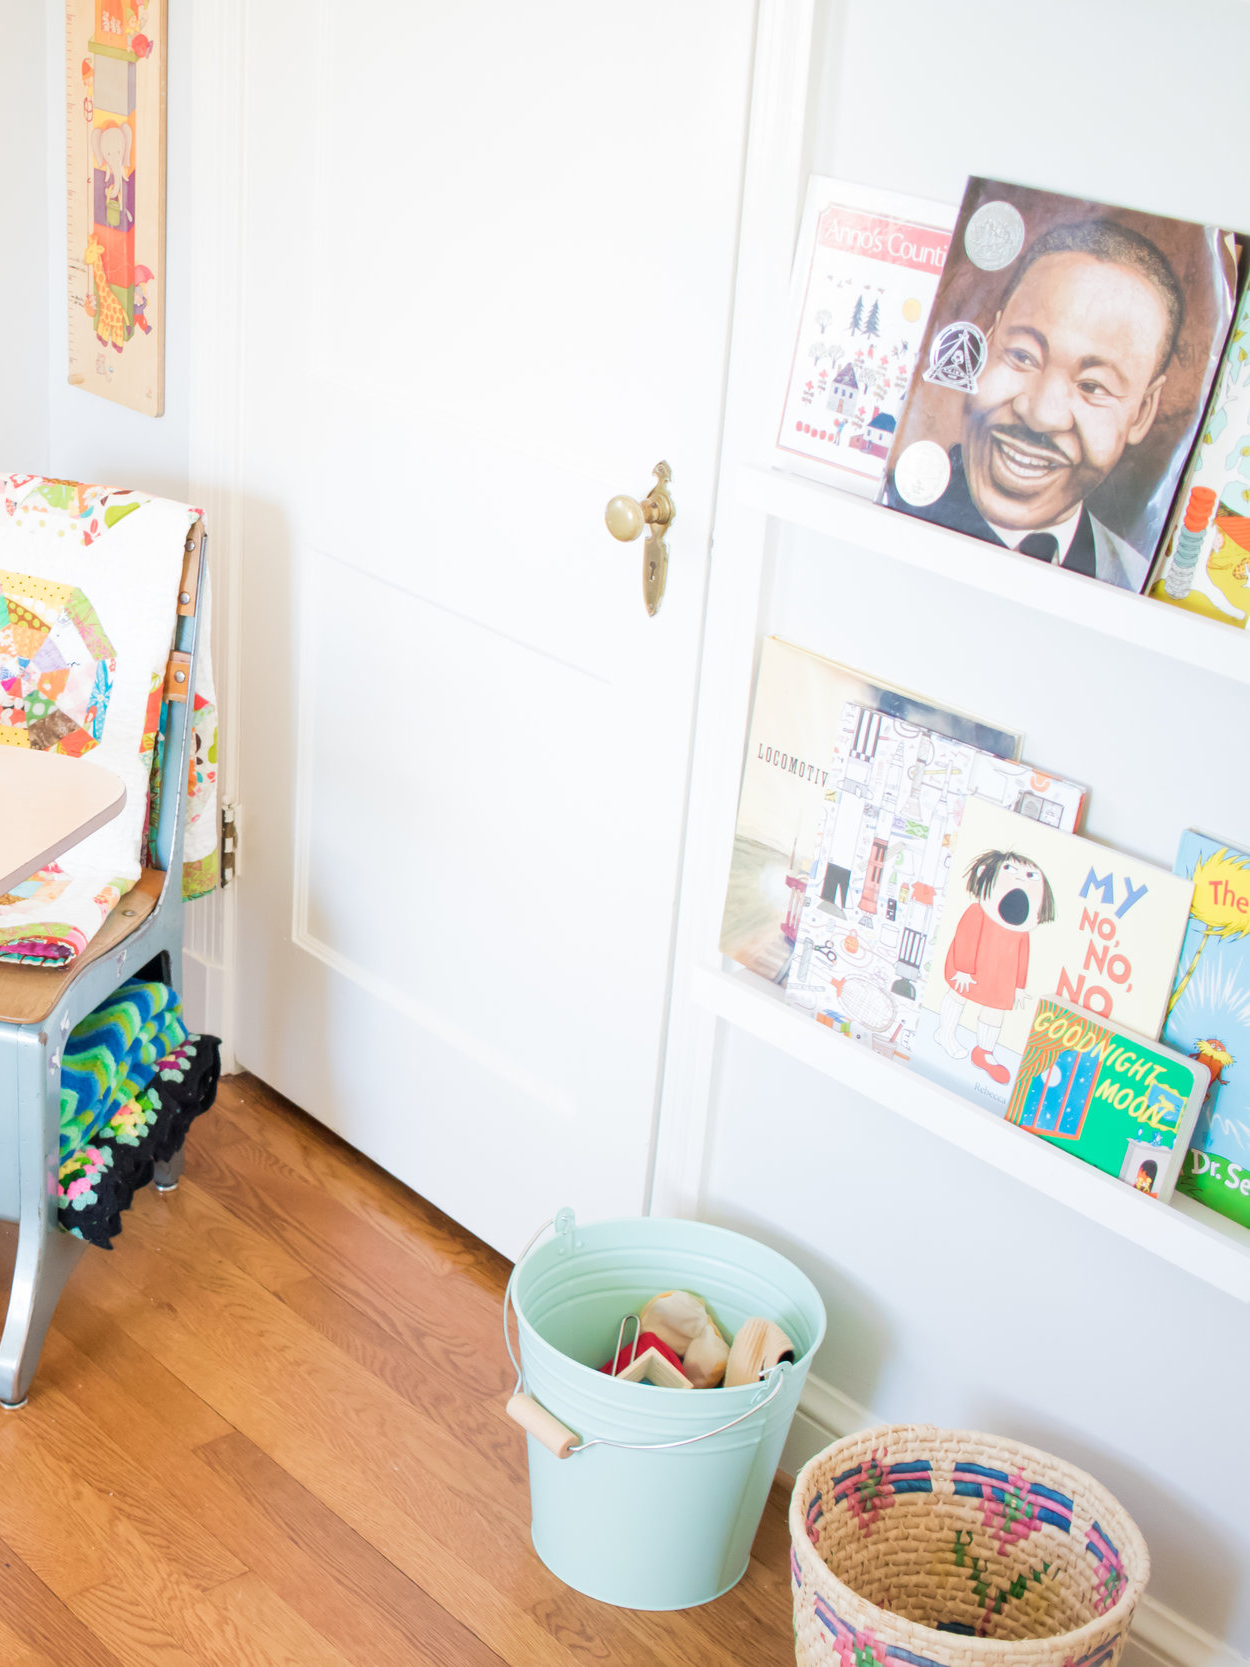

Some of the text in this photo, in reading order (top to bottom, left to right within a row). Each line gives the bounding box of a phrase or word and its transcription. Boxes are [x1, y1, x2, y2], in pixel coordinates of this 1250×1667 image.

[825, 219, 883, 253] Anno's
[757, 742, 829, 788] LOCOMOTIV
[1078, 866, 1149, 920] MY
[1208, 880, 1249, 914] The
[1079, 905, 1121, 949] NO,
[1082, 938, 1133, 993] NO,
[1033, 1012, 1168, 1086] GOODNIGHT
[974, 1081, 1007, 1106] Rebecca
[1093, 1077, 1169, 1126] MOON
[1190, 1147, 1222, 1180] Dr.
